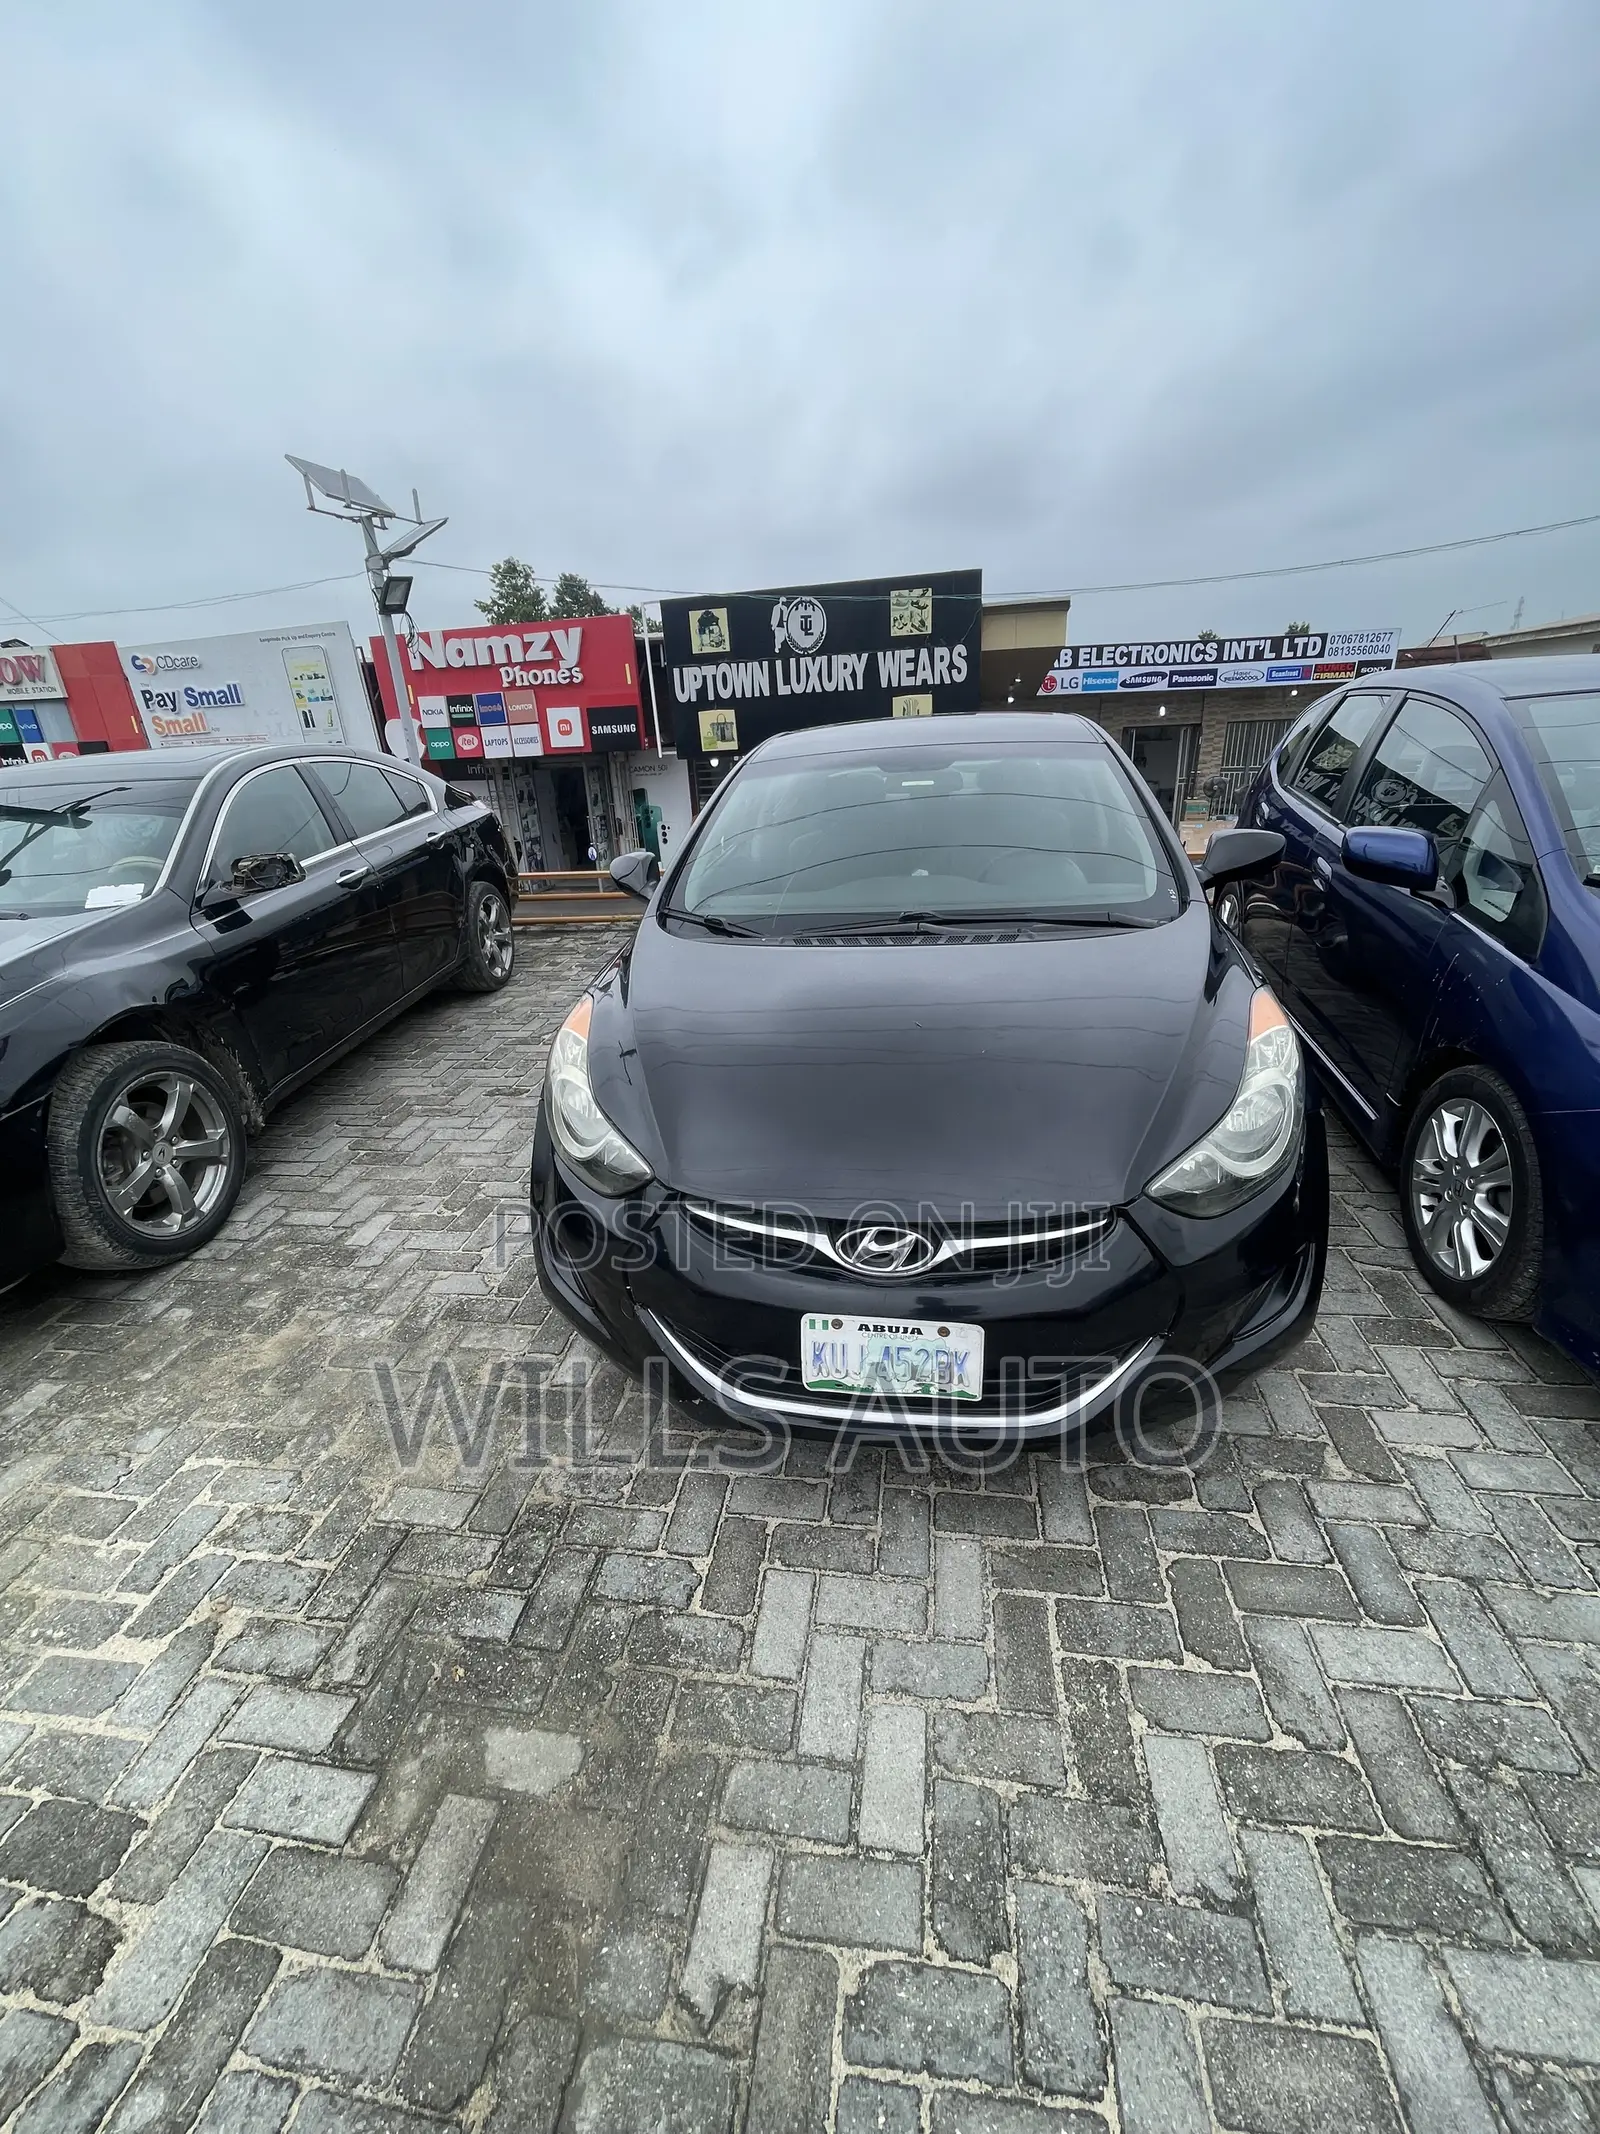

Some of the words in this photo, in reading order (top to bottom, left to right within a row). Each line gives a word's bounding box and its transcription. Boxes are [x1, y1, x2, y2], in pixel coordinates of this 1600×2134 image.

[1330, 632, 1394, 645] 07067812677
[405, 626, 583, 671] Namzy
[1078, 642, 1218, 667] ELECTRONICS
[1223, 639, 1276, 661] INT'L
[1281, 636, 1322, 658] LTD
[1327, 643, 1391, 657] 08135560040
[156, 655, 199, 670] CDcare
[1317, 663, 1354, 672] SUMEC
[672, 660, 770, 703] UPTOWN
[775, 653, 868, 696] LUXURY
[877, 643, 968, 688] WEARS
[1360, 666, 1387, 674] SONY
[499, 664, 584, 688] Phones
[1083, 676, 1118, 686] Hisense
[1126, 675, 1162, 684] SAMSUNG
[1172, 673, 1214, 683] Panasonic
[1060, 676, 1079, 690] LG
[31, 686, 57, 694] STATION
[140, 689, 177, 712] Pay
[184, 683, 242, 708] Small
[422, 708, 444, 716] NOKIA
[449, 704, 473, 713] Infinix
[508, 703, 533, 711] LONTOR
[152, 712, 207, 736] Small
[591, 723, 636, 734] SAMSUNG
[461, 737, 475, 746] itel
[484, 738, 508, 747] LAPTOPS
[857, 1323, 924, 1336] ABUJA
